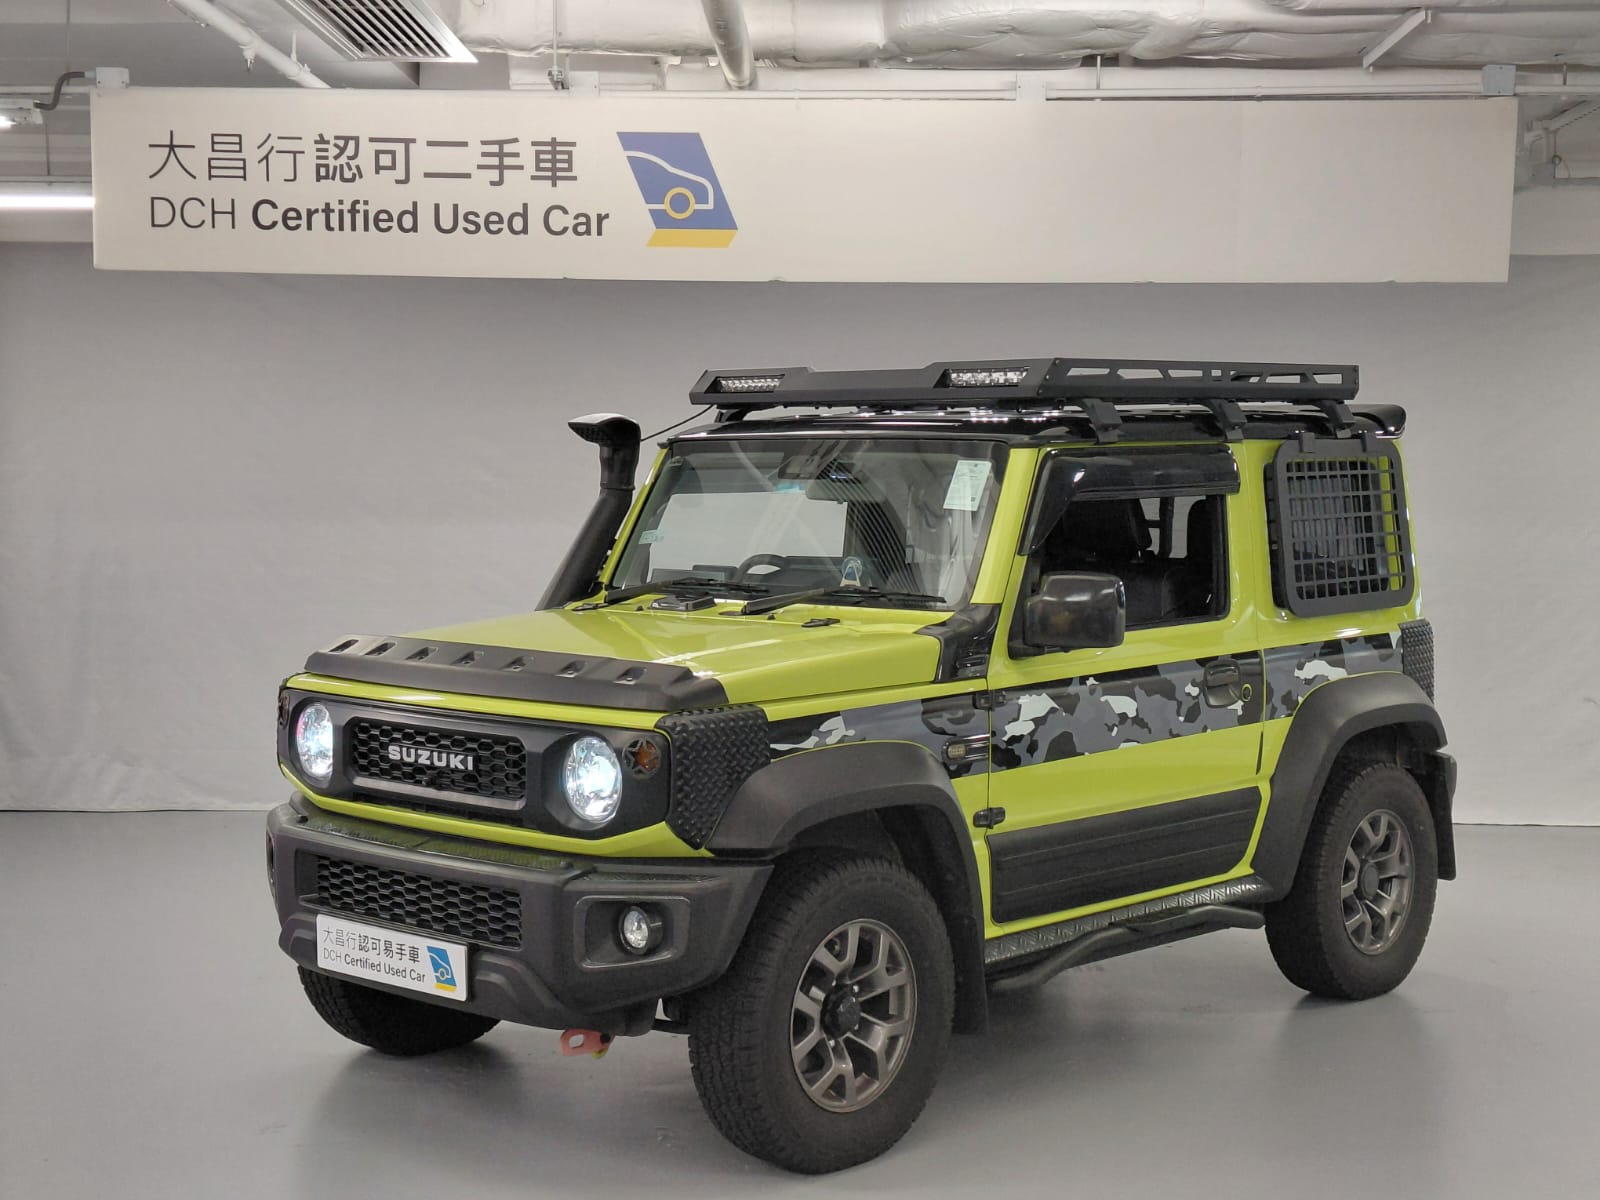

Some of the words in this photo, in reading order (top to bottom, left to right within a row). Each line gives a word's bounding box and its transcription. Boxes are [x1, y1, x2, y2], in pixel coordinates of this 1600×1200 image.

[148, 129, 578, 188] 大昌行認可二手車
[149, 196, 237, 230] DCH
[251, 198, 419, 234] Certified
[433, 202, 529, 236] Used
[542, 204, 610, 237] Car
[388, 745, 474, 771] SUZUKI
[322, 926, 420, 964] 大昌行認可易手車
[323, 947, 342, 963] DCH
[344, 953, 382, 973] Certified
[384, 962, 407, 979] Used
[409, 969, 427, 983] Car
